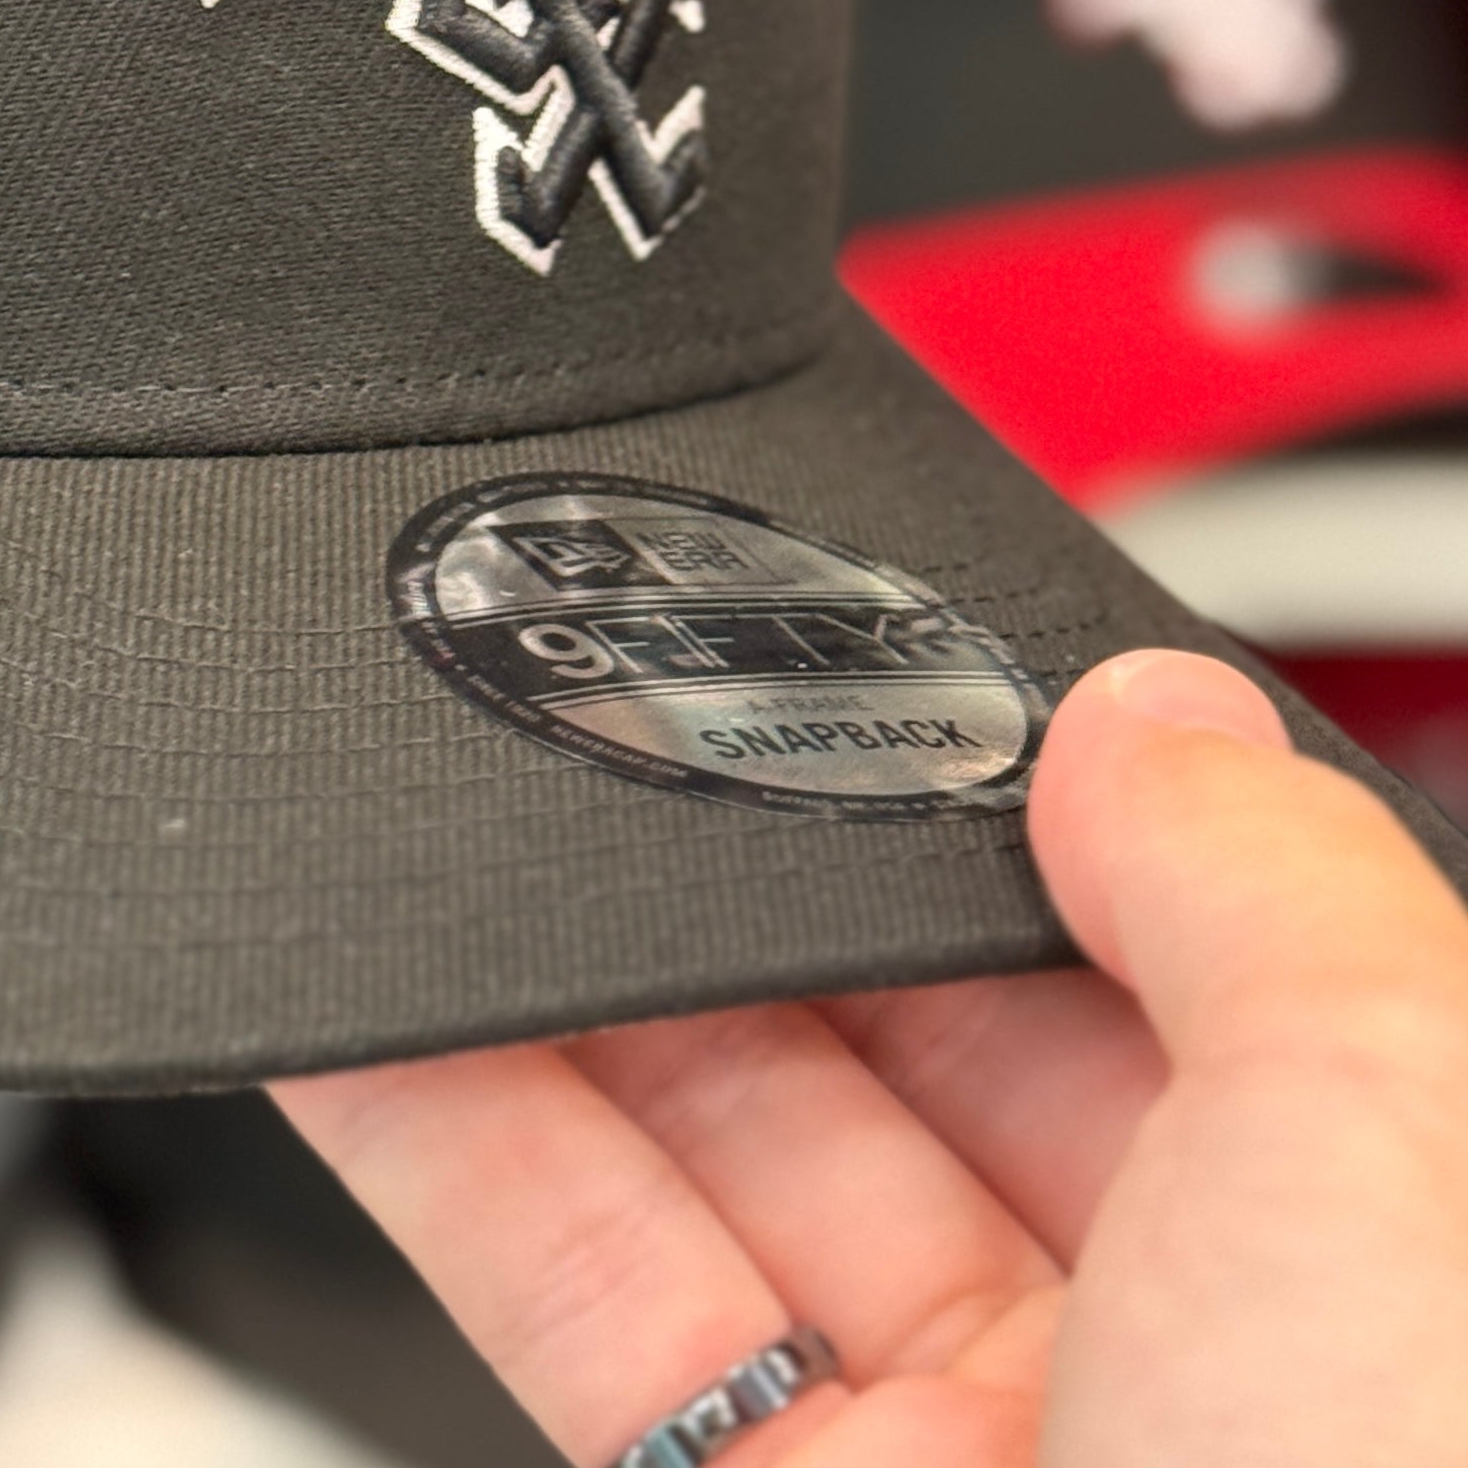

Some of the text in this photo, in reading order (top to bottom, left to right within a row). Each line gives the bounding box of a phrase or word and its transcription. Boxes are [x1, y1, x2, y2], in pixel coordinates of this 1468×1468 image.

[635, 531, 728, 551] NEW
[658, 550, 750, 571] ERA
[518, 613, 909, 679] 9FIFTY
[698, 718, 983, 760] SNAPBACK
